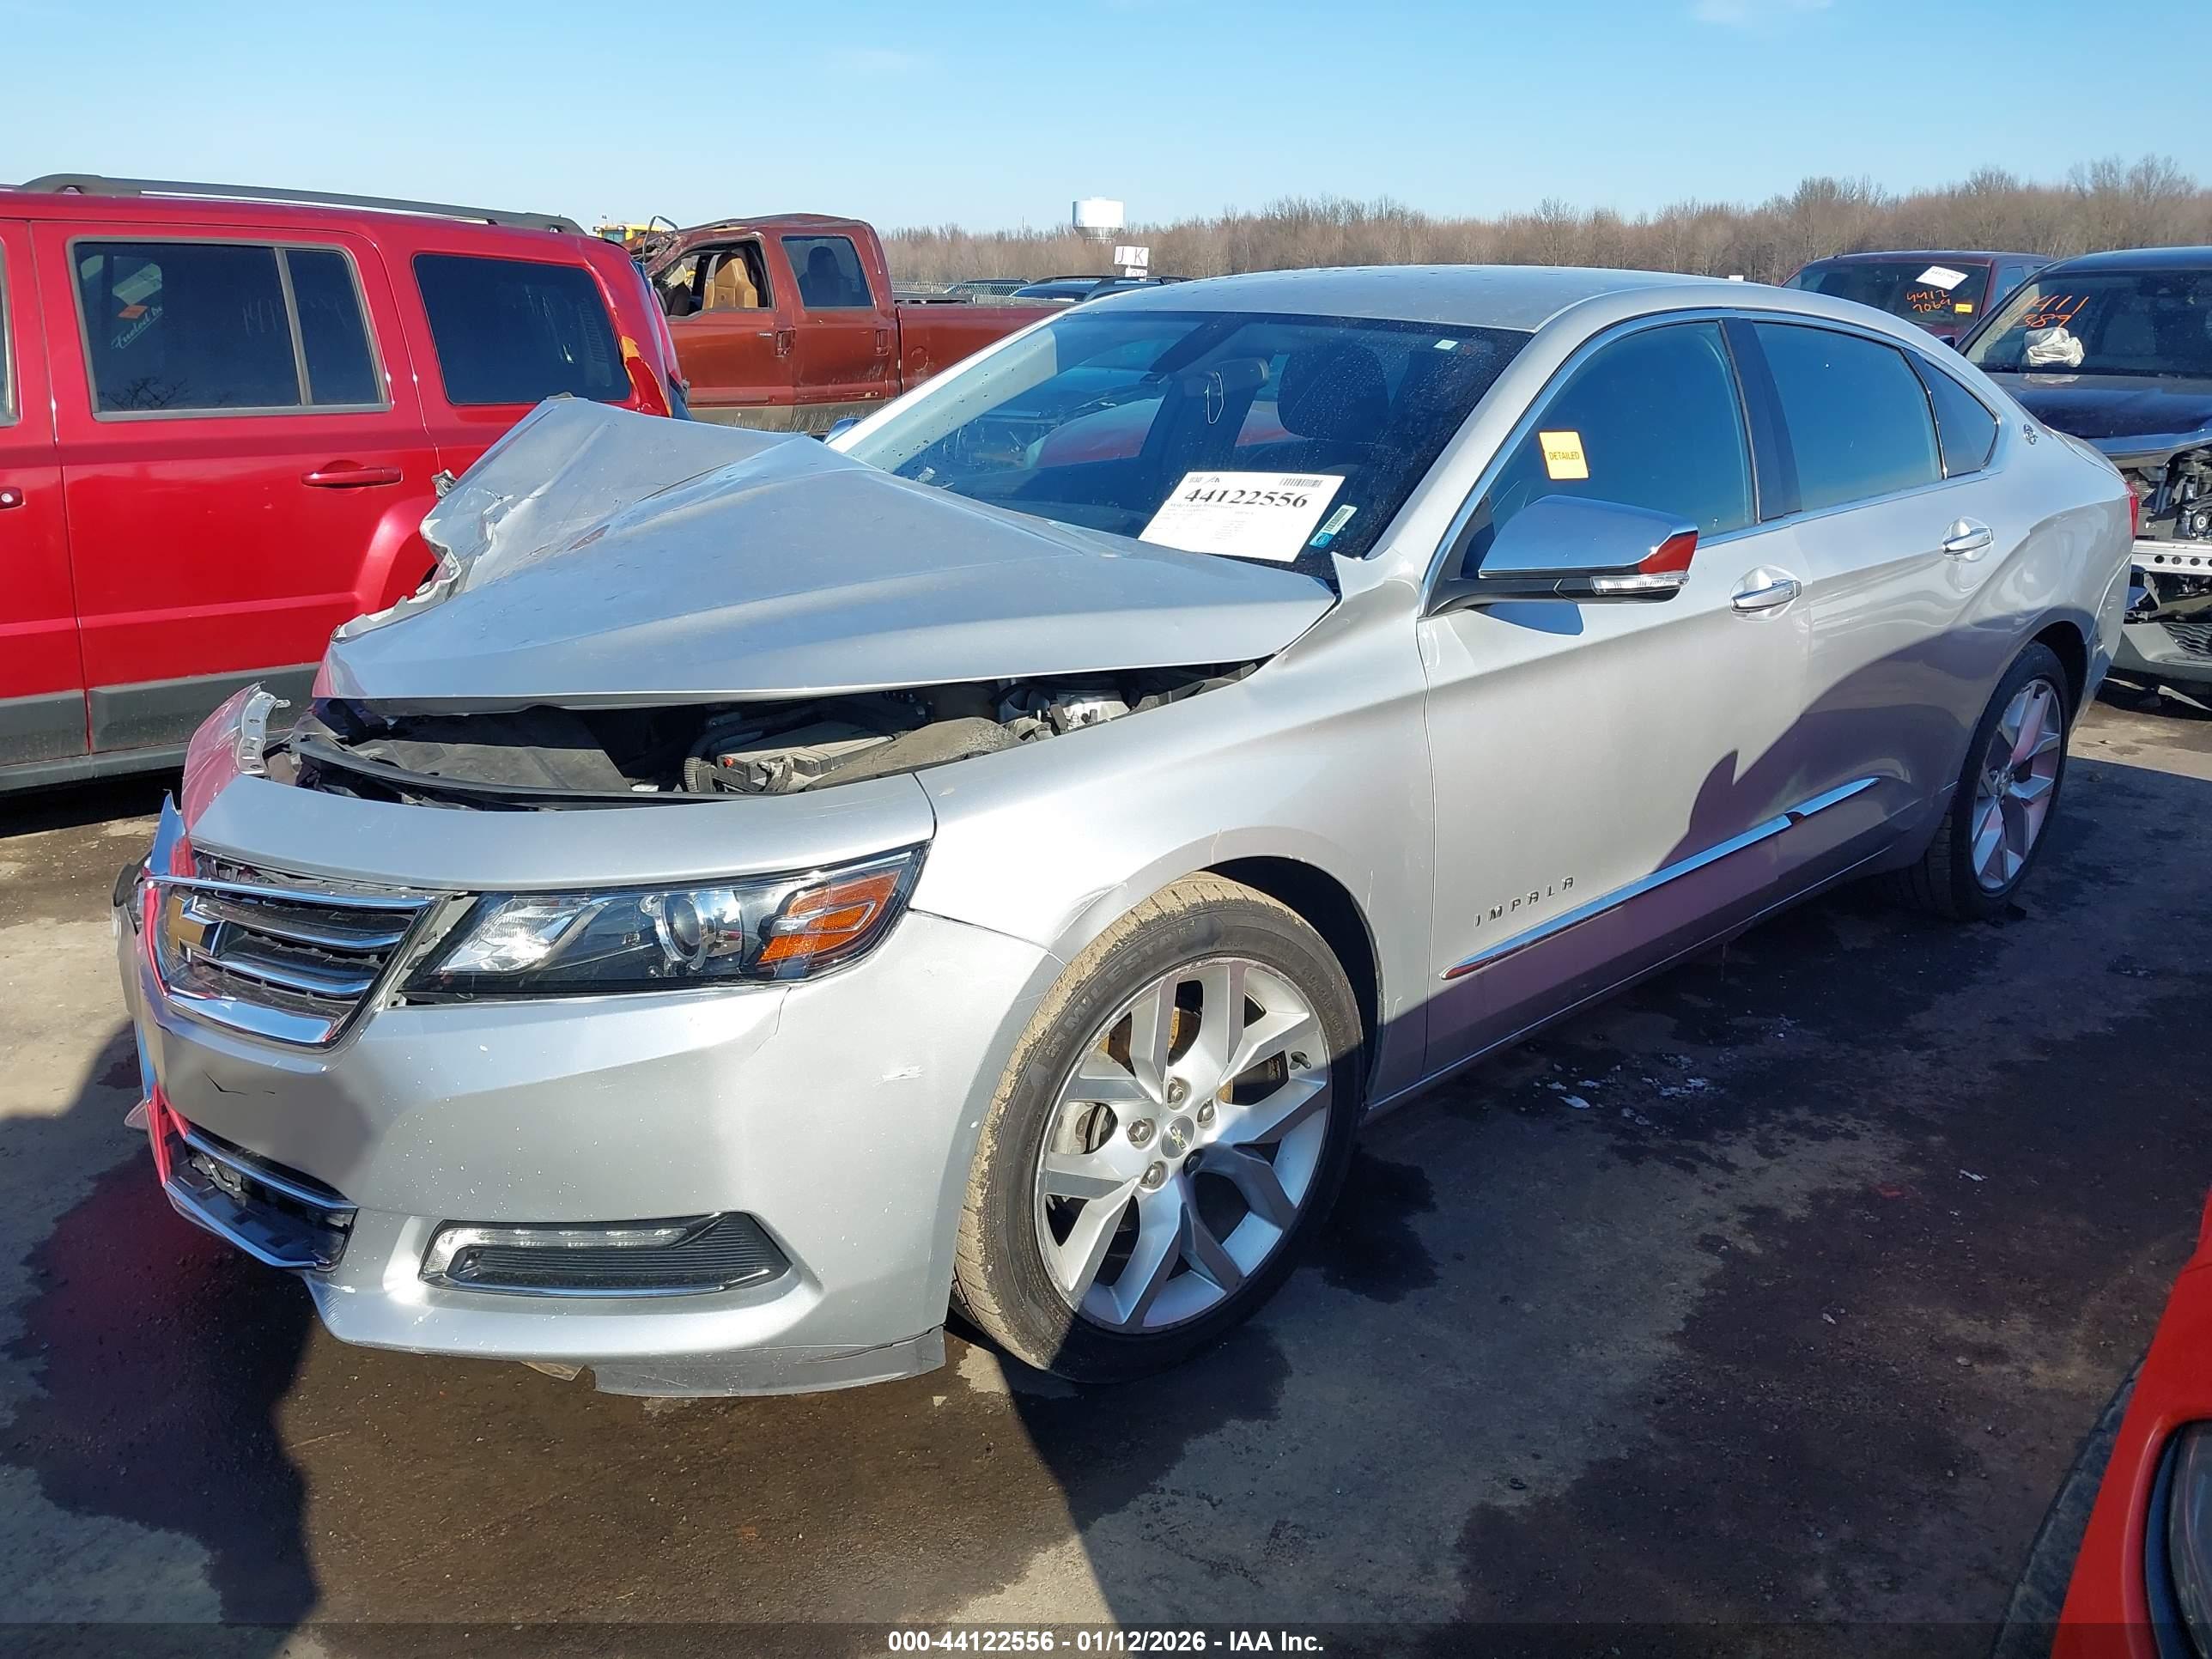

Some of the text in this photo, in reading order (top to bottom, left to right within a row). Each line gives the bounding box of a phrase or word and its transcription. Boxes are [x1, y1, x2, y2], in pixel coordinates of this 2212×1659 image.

[1548, 451, 1580, 460] DETAILED
[1184, 488, 1312, 508] 44122556
[1474, 876, 1574, 927] IMPALA
